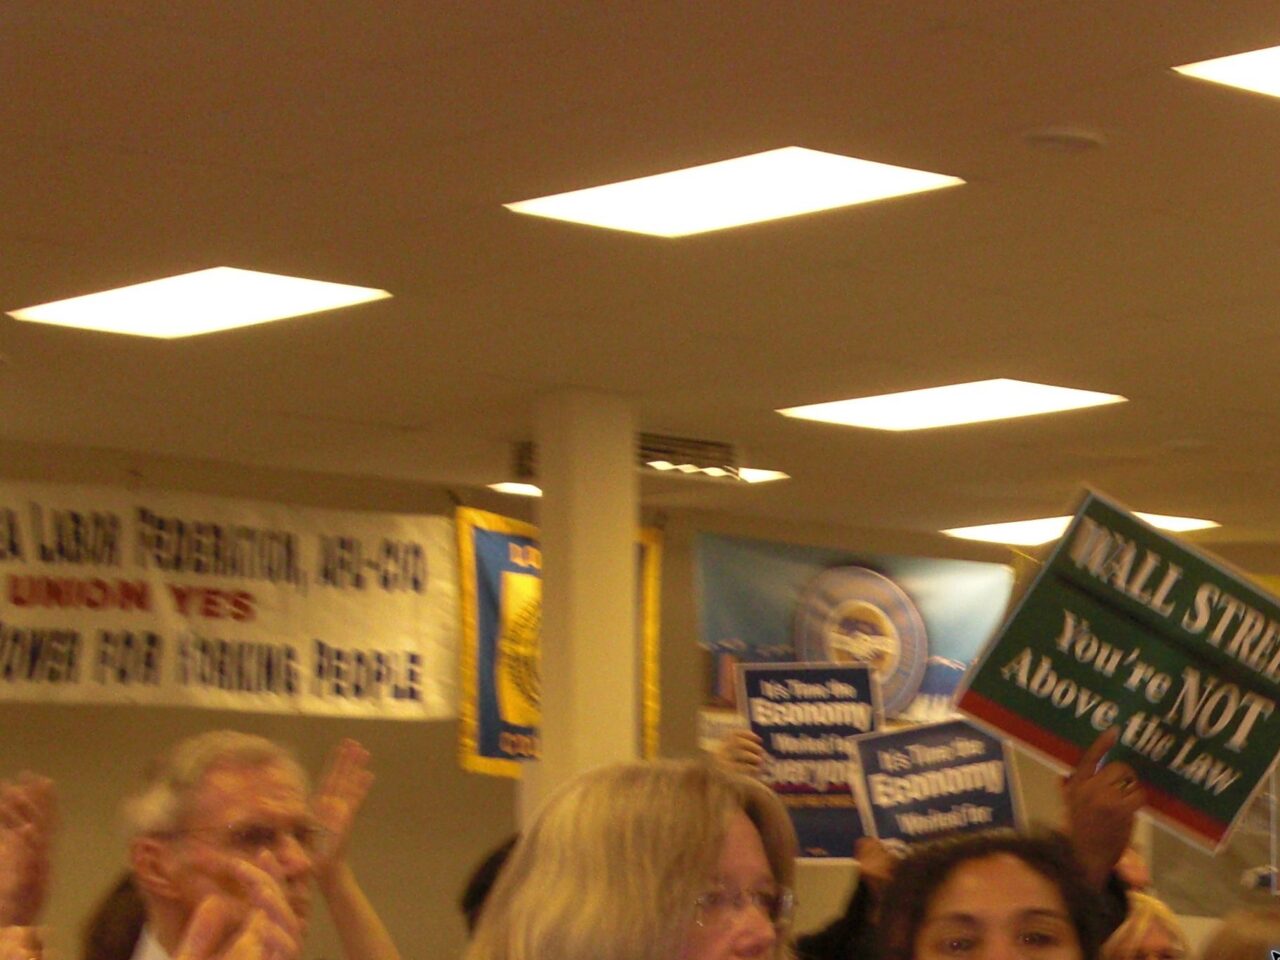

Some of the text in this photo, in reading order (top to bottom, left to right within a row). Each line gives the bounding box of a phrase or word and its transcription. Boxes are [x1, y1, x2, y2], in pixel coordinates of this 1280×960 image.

[6, 574, 257, 622] UNION YES
[1069, 515, 1184, 619] WALL
[312, 639, 424, 702] PEOPLE
[1000, 646, 1244, 797] Above the Law
[1055, 608, 1276, 753] You're NOT
